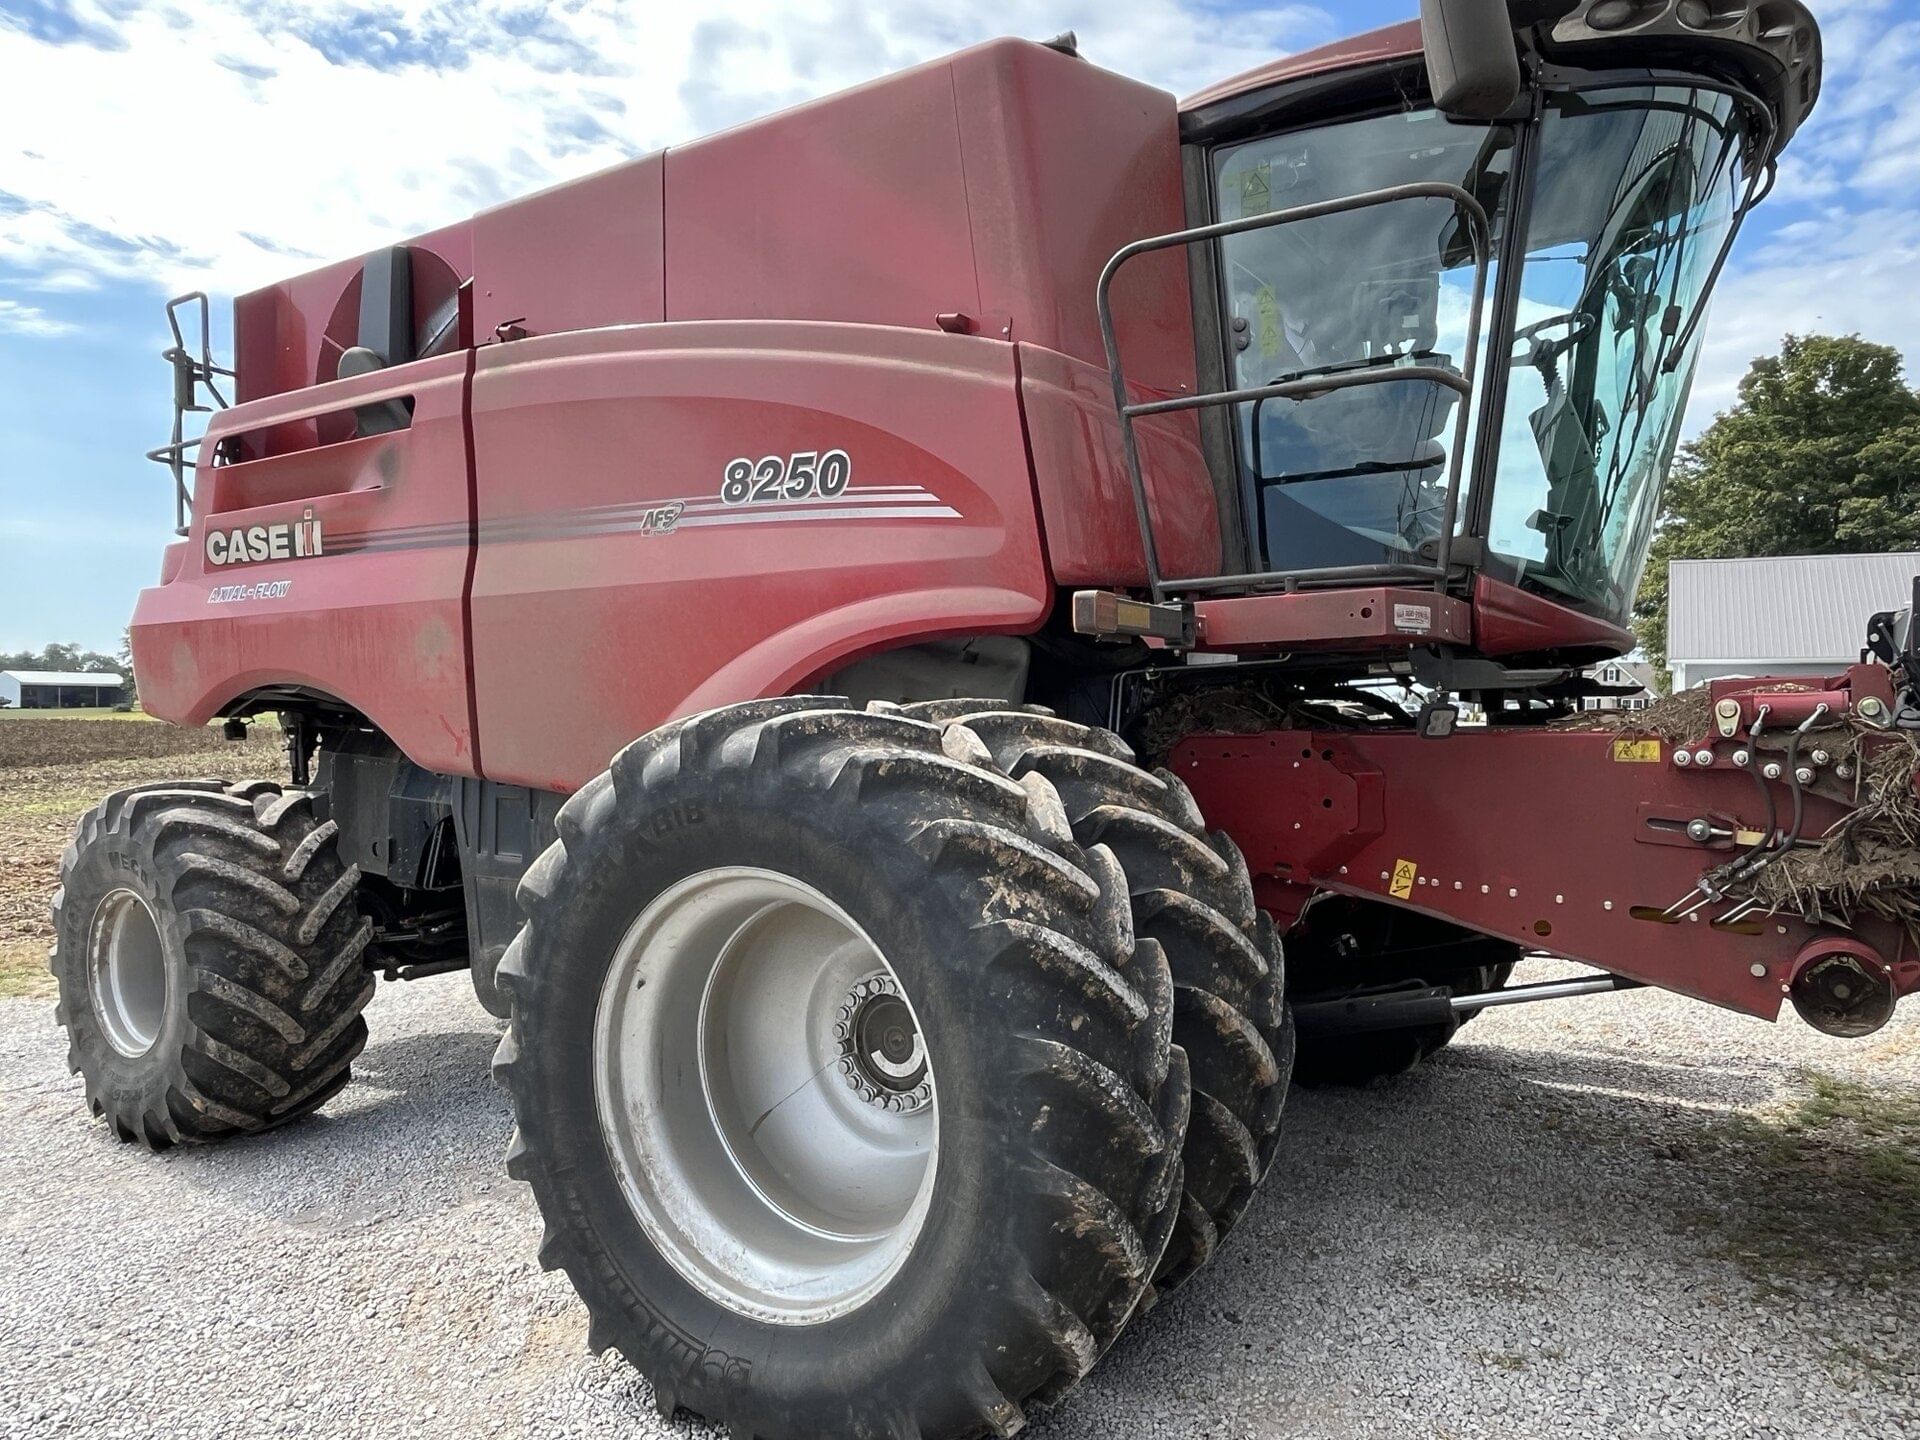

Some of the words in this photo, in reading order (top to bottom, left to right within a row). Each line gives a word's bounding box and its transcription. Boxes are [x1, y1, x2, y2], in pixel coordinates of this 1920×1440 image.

[721, 449, 851, 505] 8250
[641, 506, 679, 530] AFS
[206, 524, 290, 565] CASE
[207, 580, 292, 604] AXIAL-FLOW
